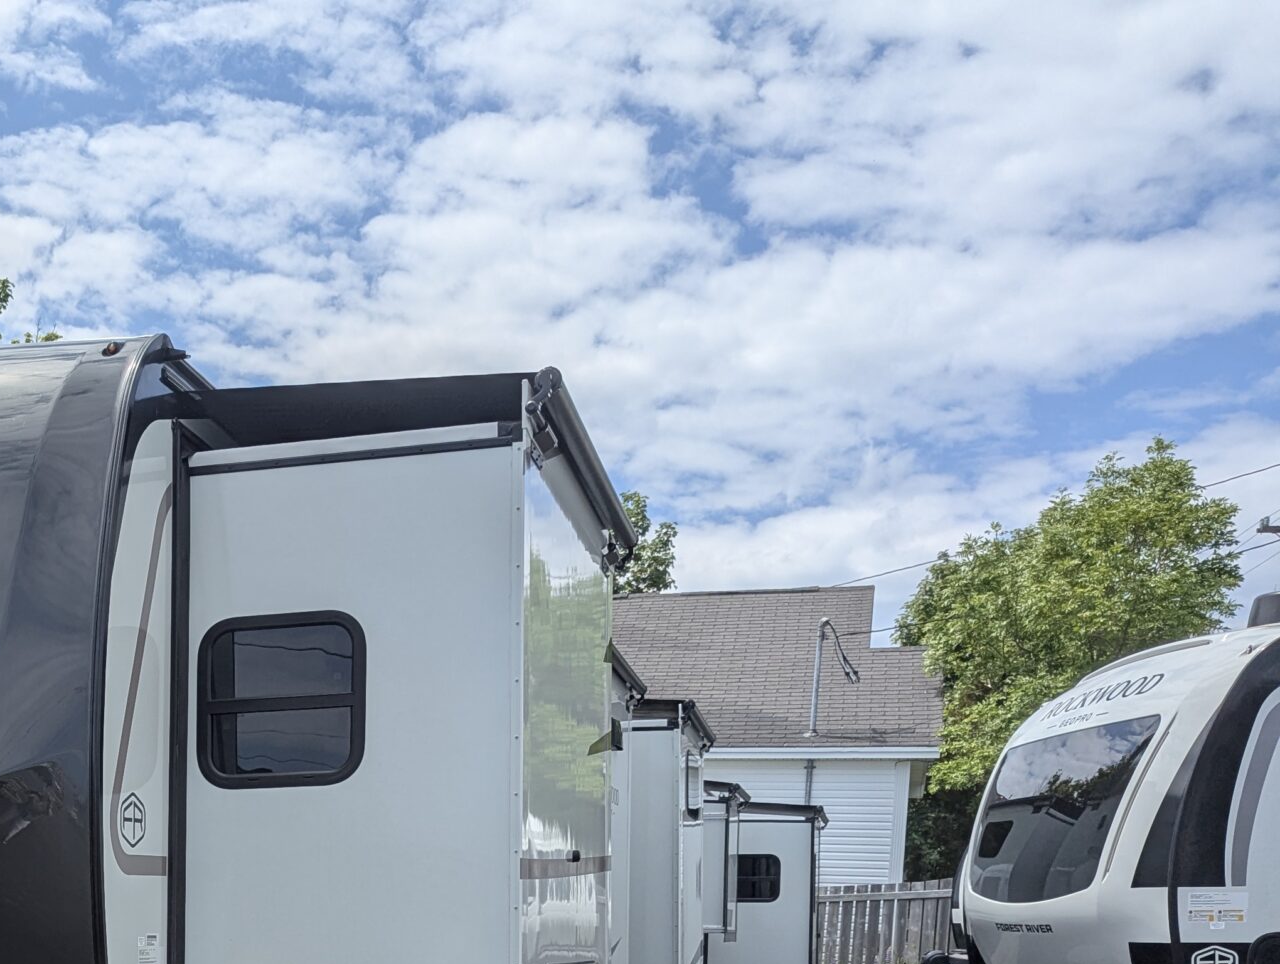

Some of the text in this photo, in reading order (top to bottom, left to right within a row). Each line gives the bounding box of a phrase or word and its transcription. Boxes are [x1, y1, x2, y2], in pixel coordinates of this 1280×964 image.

[1041, 673, 1166, 721] ROCKWOOD
[995, 922, 1054, 934] FOREST RIVER
